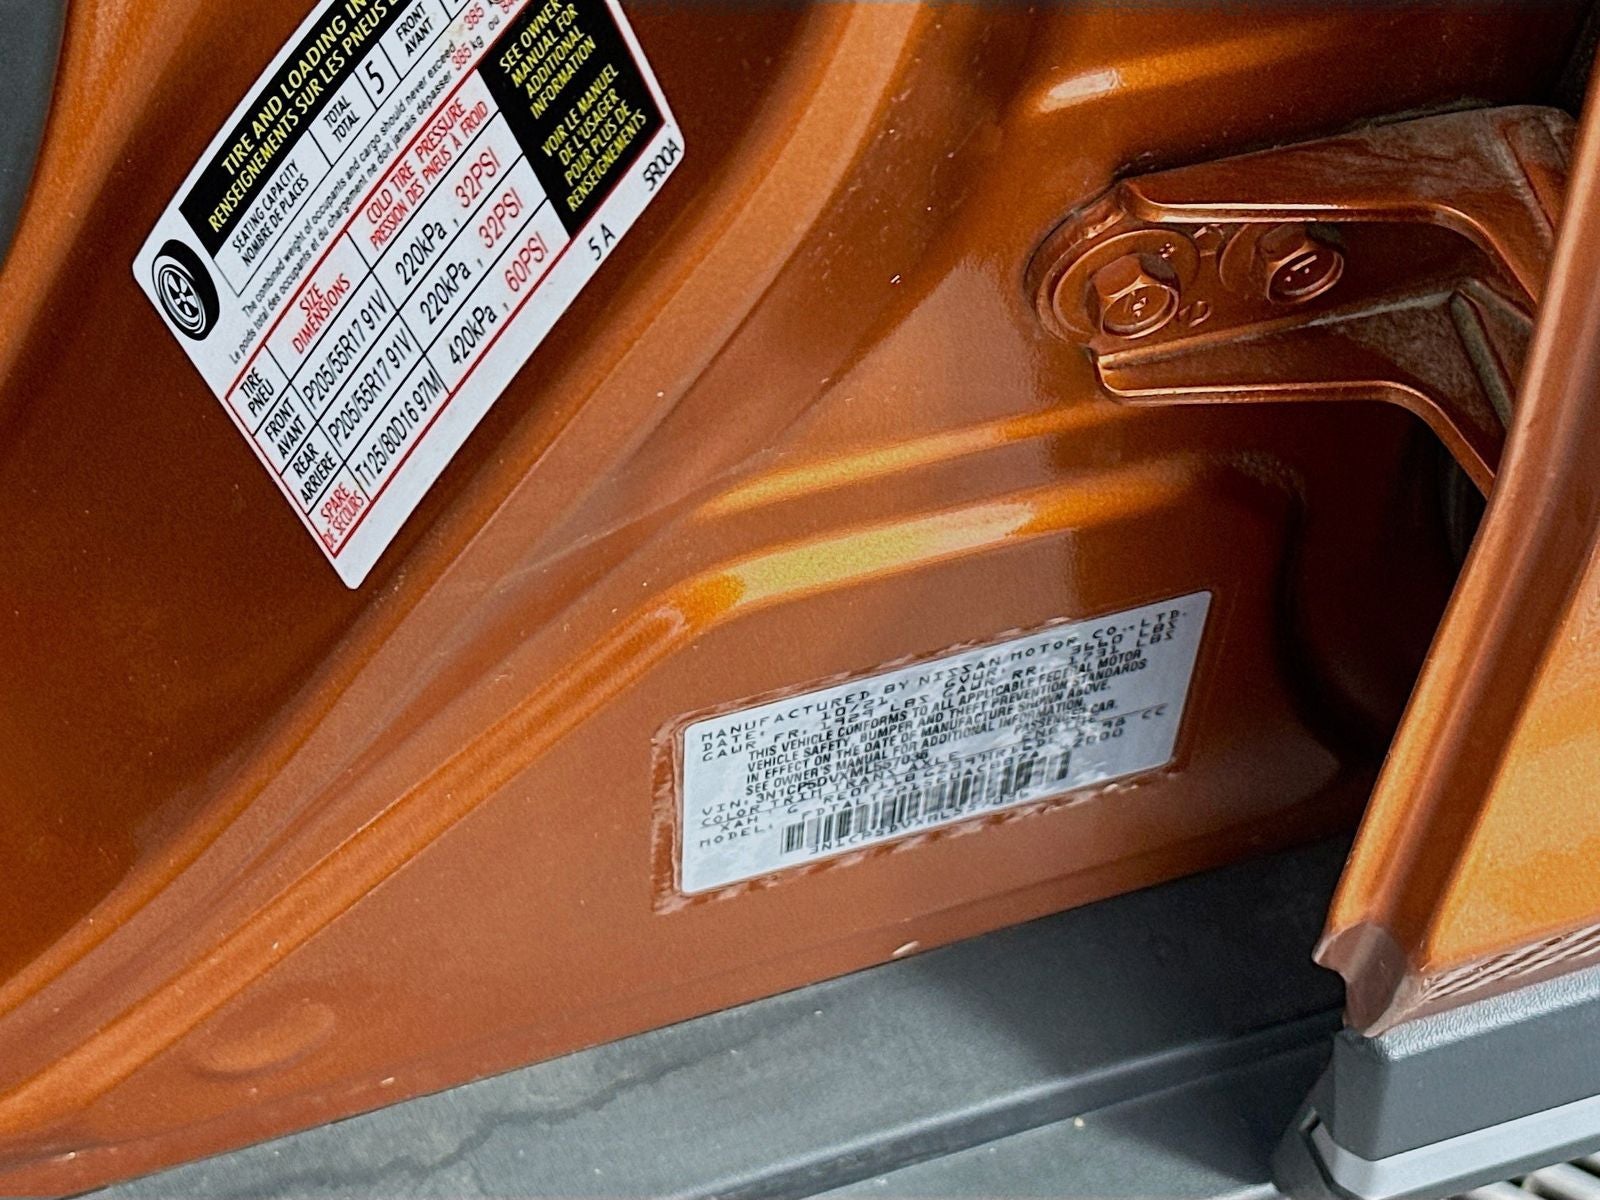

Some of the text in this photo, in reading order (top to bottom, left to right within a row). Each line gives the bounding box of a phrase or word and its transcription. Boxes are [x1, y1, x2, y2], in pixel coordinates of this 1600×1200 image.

[395, 0, 427, 43] FRONT
[404, 15, 434, 58] AVANT
[498, 41, 524, 75] SEE
[510, 2, 579, 89] MANUAL FOR
[221, 132, 255, 176] TIRE
[251, 94, 283, 140] AND
[279, 13, 347, 100] LOADING
[364, 59, 386, 96] 5
[525, 23, 585, 105] ADDITIONAL
[529, 33, 596, 121] INFORMATION
[207, 0, 388, 233] RENSEIGNEMENTS SUR LES PNEUS
[322, 94, 352, 129] TOTAL
[331, 108, 361, 144] TOTAL
[541, 61, 619, 158] VOIR LE MANUEL
[558, 86, 620, 167] DE L'USAGER
[563, 99, 632, 188] POUR PLUS DE
[228, 349, 242, 366] Le
[237, 327, 258, 357] poids
[252, 305, 270, 331] total
[266, 291, 282, 312] des
[278, 248, 313, 296] occupants
[309, 237, 321, 253] et
[317, 225, 330, 242] du
[326, 173, 369, 230] chargement
[365, 161, 379, 178] ne
[373, 139, 394, 166] doit
[390, 108, 418, 150] jamais
[415, 60, 453, 117] dépasser
[451, 41, 473, 72] 385
[469, 34, 485, 52] kg
[487, 14, 501, 32] ou
[241, 0, 485, 319] The combined weight of occupants and cargo should never exceed 385
[365, 96, 467, 225] COLD TIRE PRESSURE
[369, 99, 489, 252] PRESSION DES PNEUS À FROID
[454, 145, 501, 210] 32PSI
[566, 107, 647, 213] RENSEIGNEMENTS
[231, 158, 299, 254] SEATING CAPACITY
[240, 172, 310, 268] NOMBRE DE PLACES
[478, 186, 524, 250] 32PSI
[587, 221, 616, 262] 5 A
[298, 282, 324, 318] SIZE
[504, 230, 549, 294] 60PSI
[291, 272, 351, 355] DIMENSIONS
[302, 288, 388, 410] P205/55R17 91V
[239, 366, 264, 400] TIRE
[247, 378, 275, 418] PNEU
[263, 396, 296, 443] FRONT
[327, 327, 413, 448] P205/55R17 91V
[276, 413, 307, 460] AVANT
[292, 441, 320, 479] REAR
[354, 368, 443, 488] T125/80D16 97M
[299, 449, 337, 505] ARRIÈRE
[319, 481, 351, 525] SPARE
[321, 489, 365, 551] DE SECOURS
[1138, 618, 1178, 638] LBS
[701, 689, 871, 742] MANUFACTURED
[883, 679, 909, 695] BY
[918, 656, 1001, 687] NISSAN
[1010, 636, 1078, 661] MOTOR
[748, 744, 777, 761] THIS
[781, 729, 833, 753] VEHICLE
[837, 709, 908, 738] CONFORMS
[911, 704, 928, 718] TO
[931, 697, 955, 713] ALL
[958, 677, 1035, 707] APPLICABLE
[1095, 646, 1144, 671] MOTOR
[889, 694, 929, 713] LBS
[1135, 629, 1175, 649] LBS
[746, 772, 759, 784] IN
[764, 757, 810, 780] EFFECT
[813, 752, 832, 767] ON
[836, 745, 860, 760] THE
[864, 734, 897, 753] DATE
[900, 729, 917, 744] OF
[920, 704, 1014, 738] MANUFACTURE
[747, 750, 799, 773] VEHICLE
[860, 720, 913, 743] BUMPER
[917, 711, 944, 727] AND
[949, 699, 988, 720] THEFT
[991, 678, 1069, 708] PREVENTION
[1073, 657, 1148, 687] STANDARDS
[745, 780, 769, 796] SEE
[773, 763, 832, 788] OWNER'S
[835, 749, 888, 771] MANUAL
[892, 740, 918, 757] FOR
[920, 720, 995, 749] ADDITIONAL
[701, 804, 760, 828] COLOR
